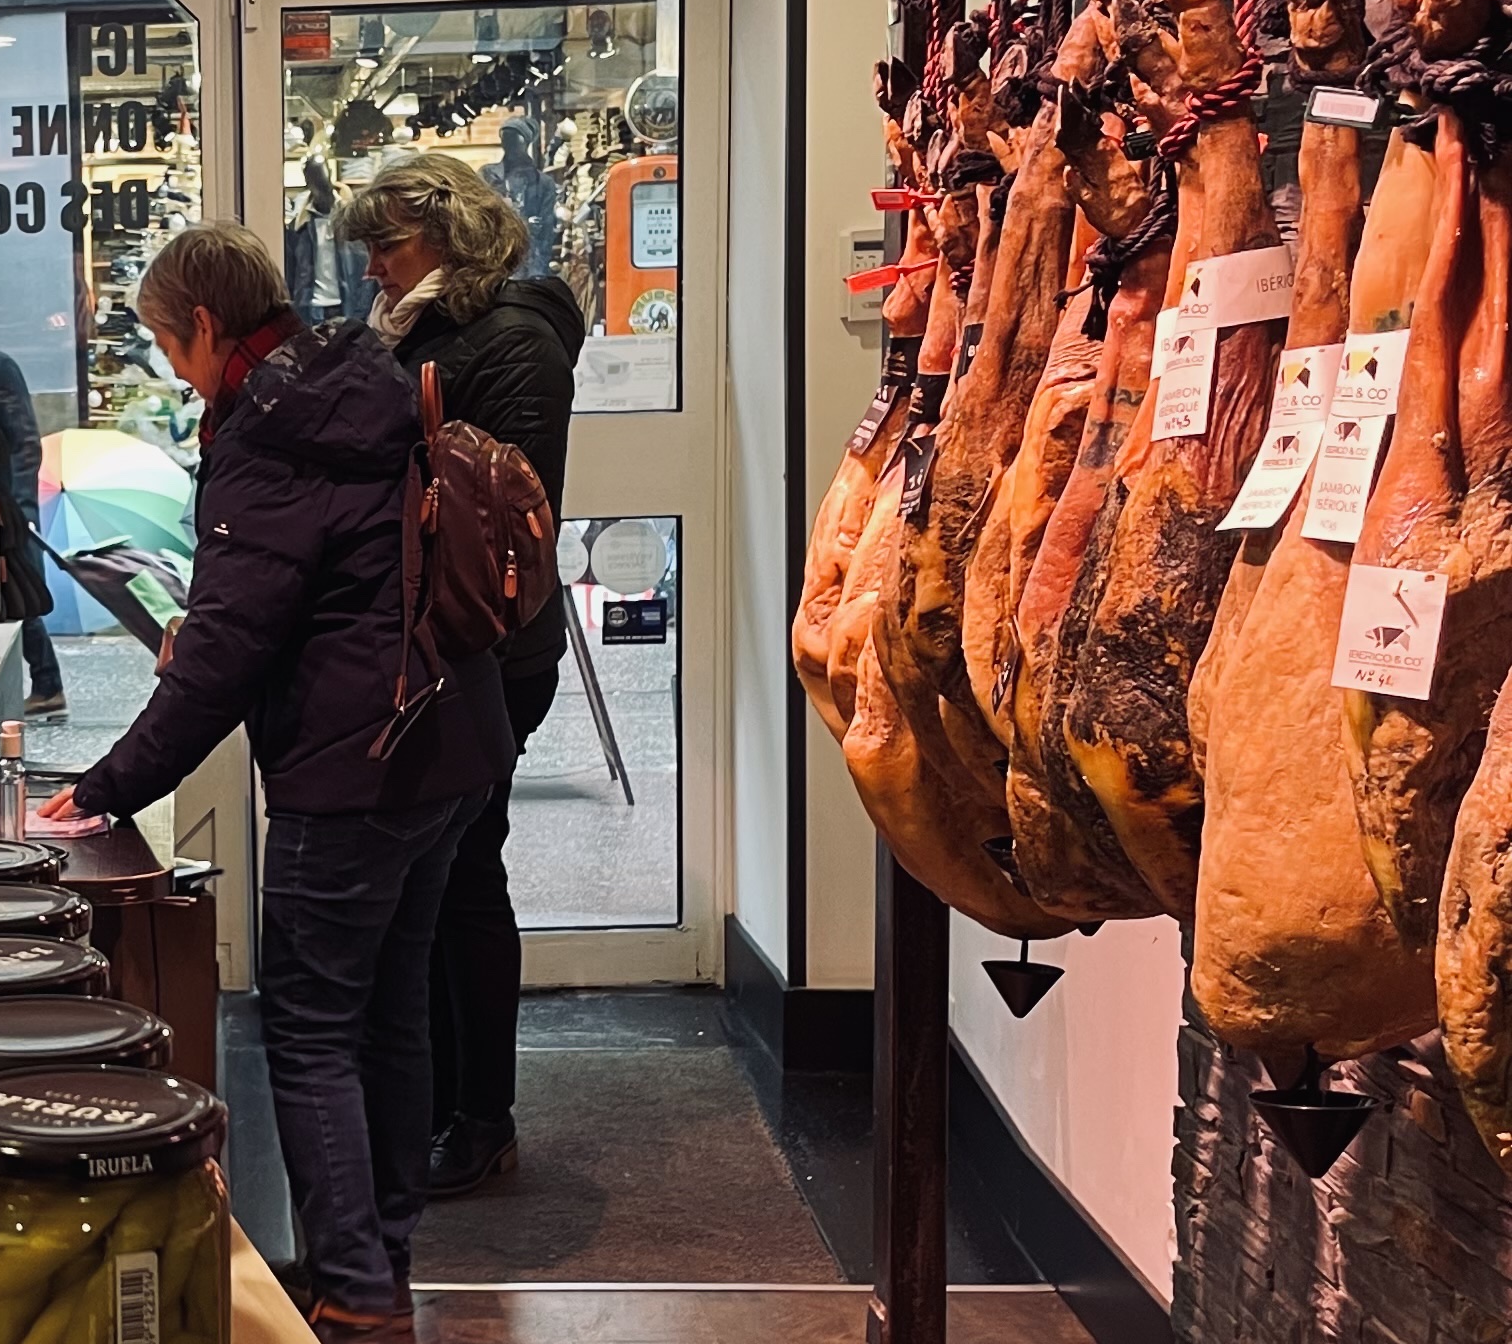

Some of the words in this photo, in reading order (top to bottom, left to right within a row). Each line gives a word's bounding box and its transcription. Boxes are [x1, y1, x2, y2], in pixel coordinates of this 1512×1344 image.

[1367, 388, 1388, 400] CO
[1301, 395, 1322, 406] CO
[1318, 482, 1362, 495] JAMBON
[1404, 657, 1422, 667] CO
[89, 1154, 153, 1177] IRUELA
